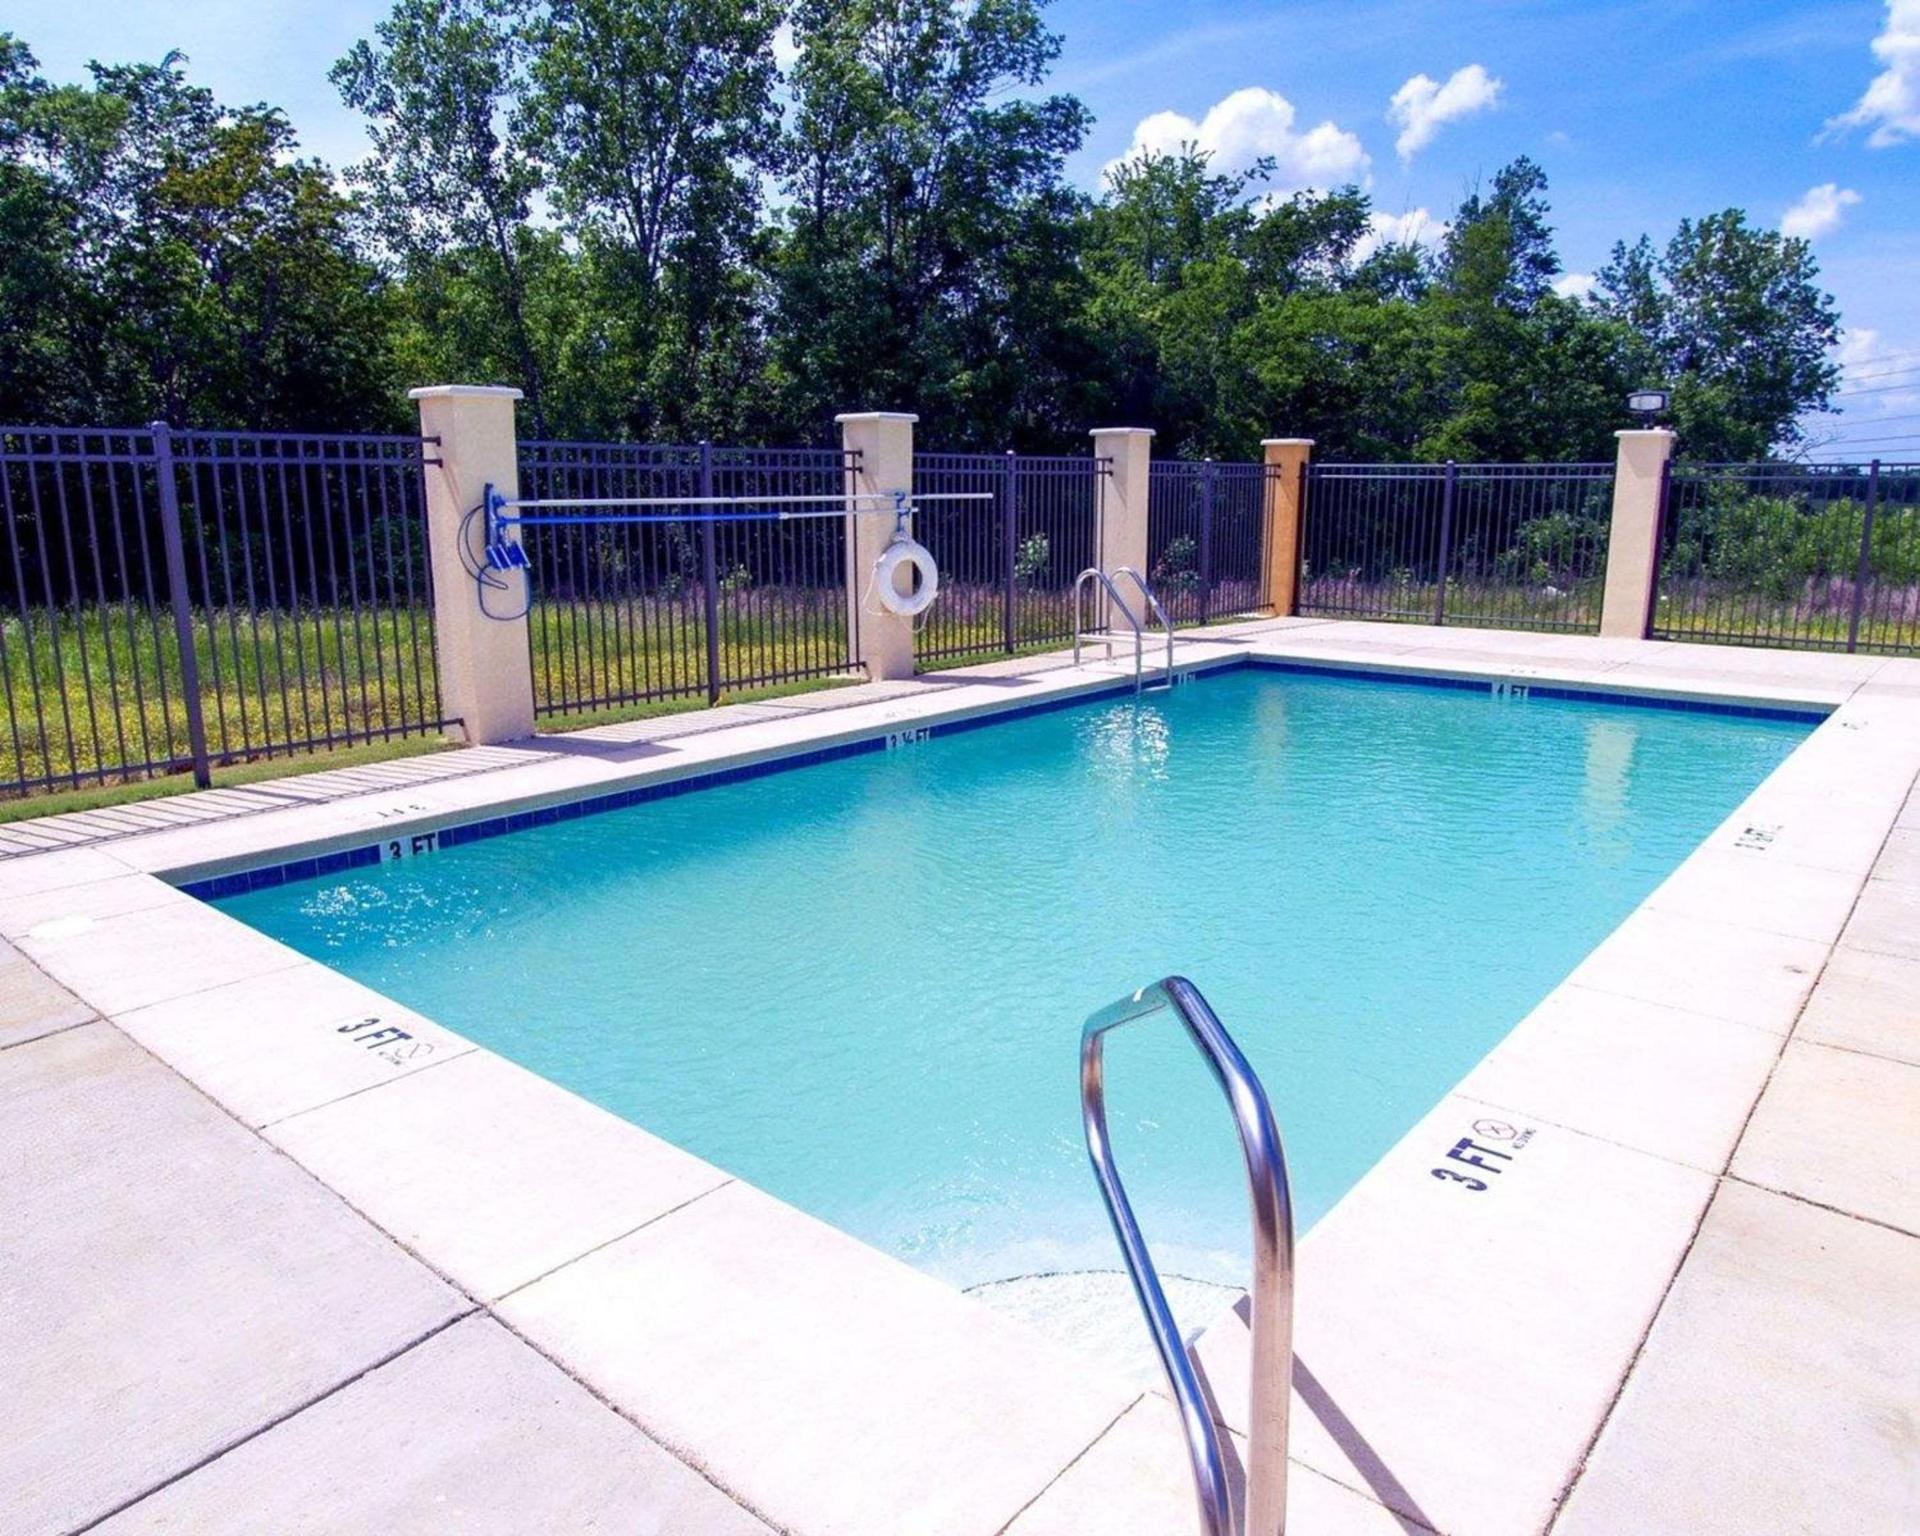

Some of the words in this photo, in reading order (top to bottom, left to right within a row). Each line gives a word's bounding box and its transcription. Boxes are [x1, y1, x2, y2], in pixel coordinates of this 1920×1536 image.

[1511, 685, 1527, 697] FT
[916, 727, 928, 741] FT
[389, 841, 402, 860] 3
[411, 832, 436, 856] FT
[337, 1018, 380, 1033] 3
[353, 1026, 413, 1049] FT
[1446, 1137, 1513, 1173] FT
[1430, 1168, 1488, 1191] 3
